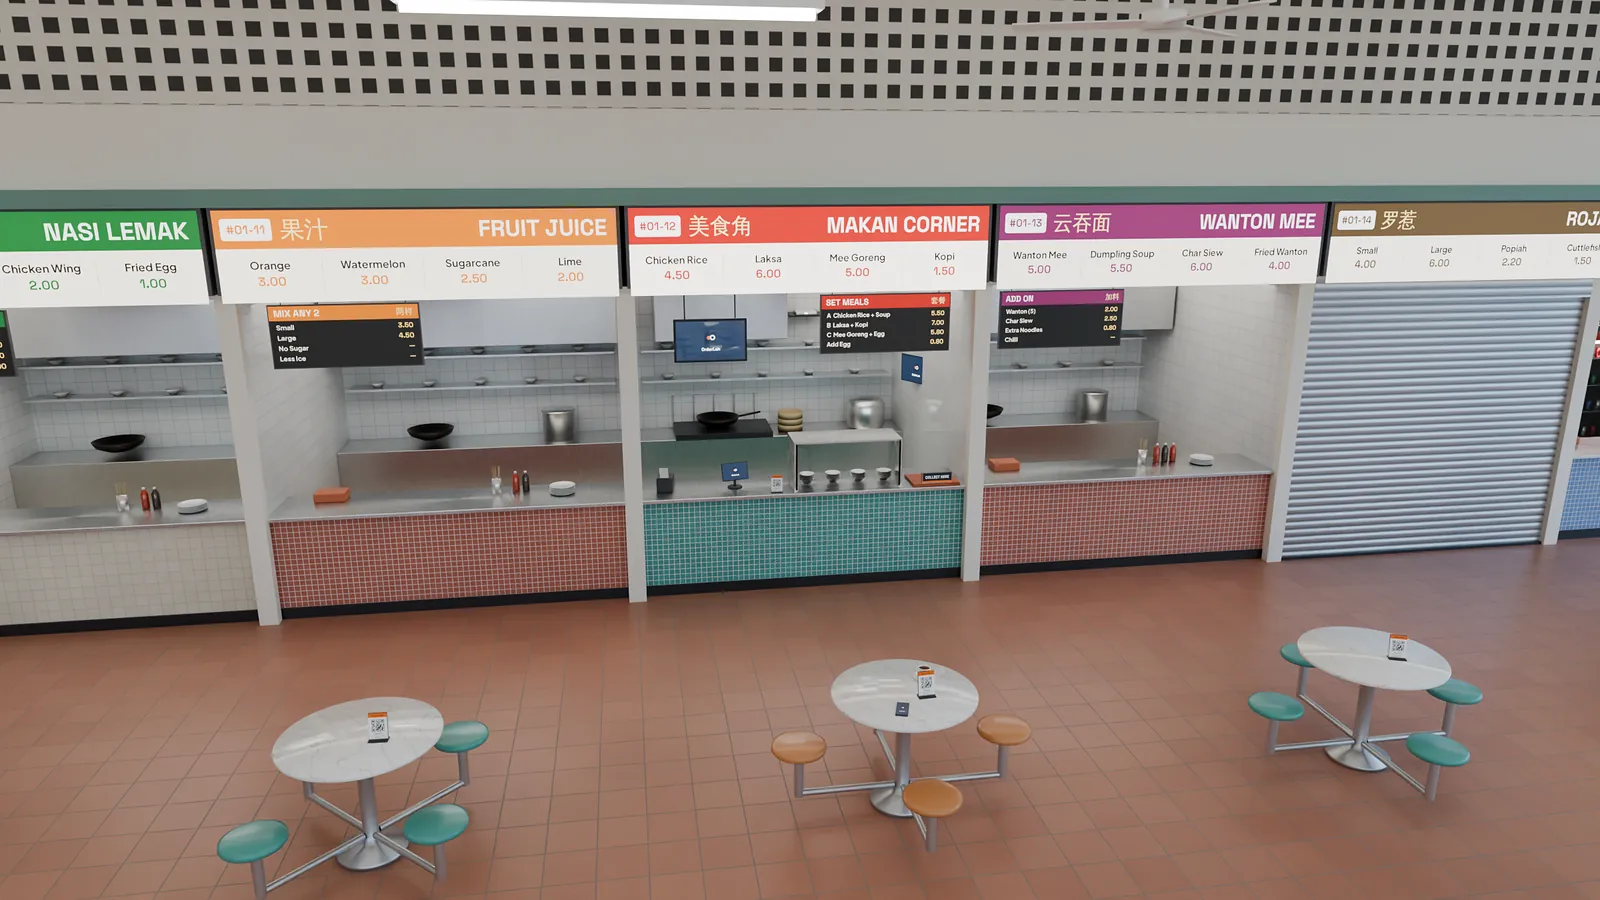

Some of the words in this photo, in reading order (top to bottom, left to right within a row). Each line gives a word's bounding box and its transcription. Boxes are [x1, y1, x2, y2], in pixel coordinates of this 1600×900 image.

[828, 216, 897, 233] MAKAN
[904, 216, 980, 233] CORNER
[1010, 219, 1042, 227] #01-13
[1054, 213, 1111, 233] 云吞面
[1200, 214, 1275, 229] WANTON
[1280, 213, 1316, 229] MEE
[1342, 216, 1371, 224] #01-14
[1381, 210, 1417, 230] 罗惹
[226, 225, 265, 234] #01-11
[280, 218, 328, 241] 果汁
[479, 219, 539, 236] FRUIT
[545, 219, 607, 236] JUICE
[640, 222, 675, 230] #01-12
[689, 215, 750, 237] 美食角
[43, 223, 99, 241] NASI
[106, 222, 189, 240] LEMAK
[1182, 249, 1201, 257] Char
[1431, 247, 1452, 255] Large
[1501, 245, 1527, 253] Popiah
[852, 254, 885, 263] Goreng
[935, 253, 954, 262] Kopi
[1091, 251, 1131, 259] Dumpling
[1133, 250, 1154, 259] Soup
[341, 260, 405, 268] Watermelon
[446, 259, 500, 269] Sugarcane
[646, 256, 685, 264] Chicken
[1355, 260, 1376, 268] 4.00
[1429, 259, 1450, 267] 6.00
[1502, 258, 1522, 266] 2.20
[2, 265, 49, 273] Chicken
[51, 264, 81, 275] Wing
[125, 263, 152, 272] Fried
[156, 263, 176, 273] Egg
[250, 262, 290, 272] Orange
[1028, 265, 1050, 274] 5.00
[1110, 264, 1132, 272] 5.50
[1191, 263, 1212, 271] 6.00
[1269, 261, 1290, 270] 4.00
[665, 271, 689, 279] 4.50
[756, 269, 780, 278] 6.00
[846, 268, 869, 276] 5.00
[934, 266, 954, 275] 1.50
[361, 275, 388, 285] 3.00
[461, 274, 487, 283] 2.50
[558, 272, 584, 281] 2.00
[29, 280, 59, 290] 2.00
[140, 279, 166, 288] 1.00
[258, 277, 286, 286] 3.00
